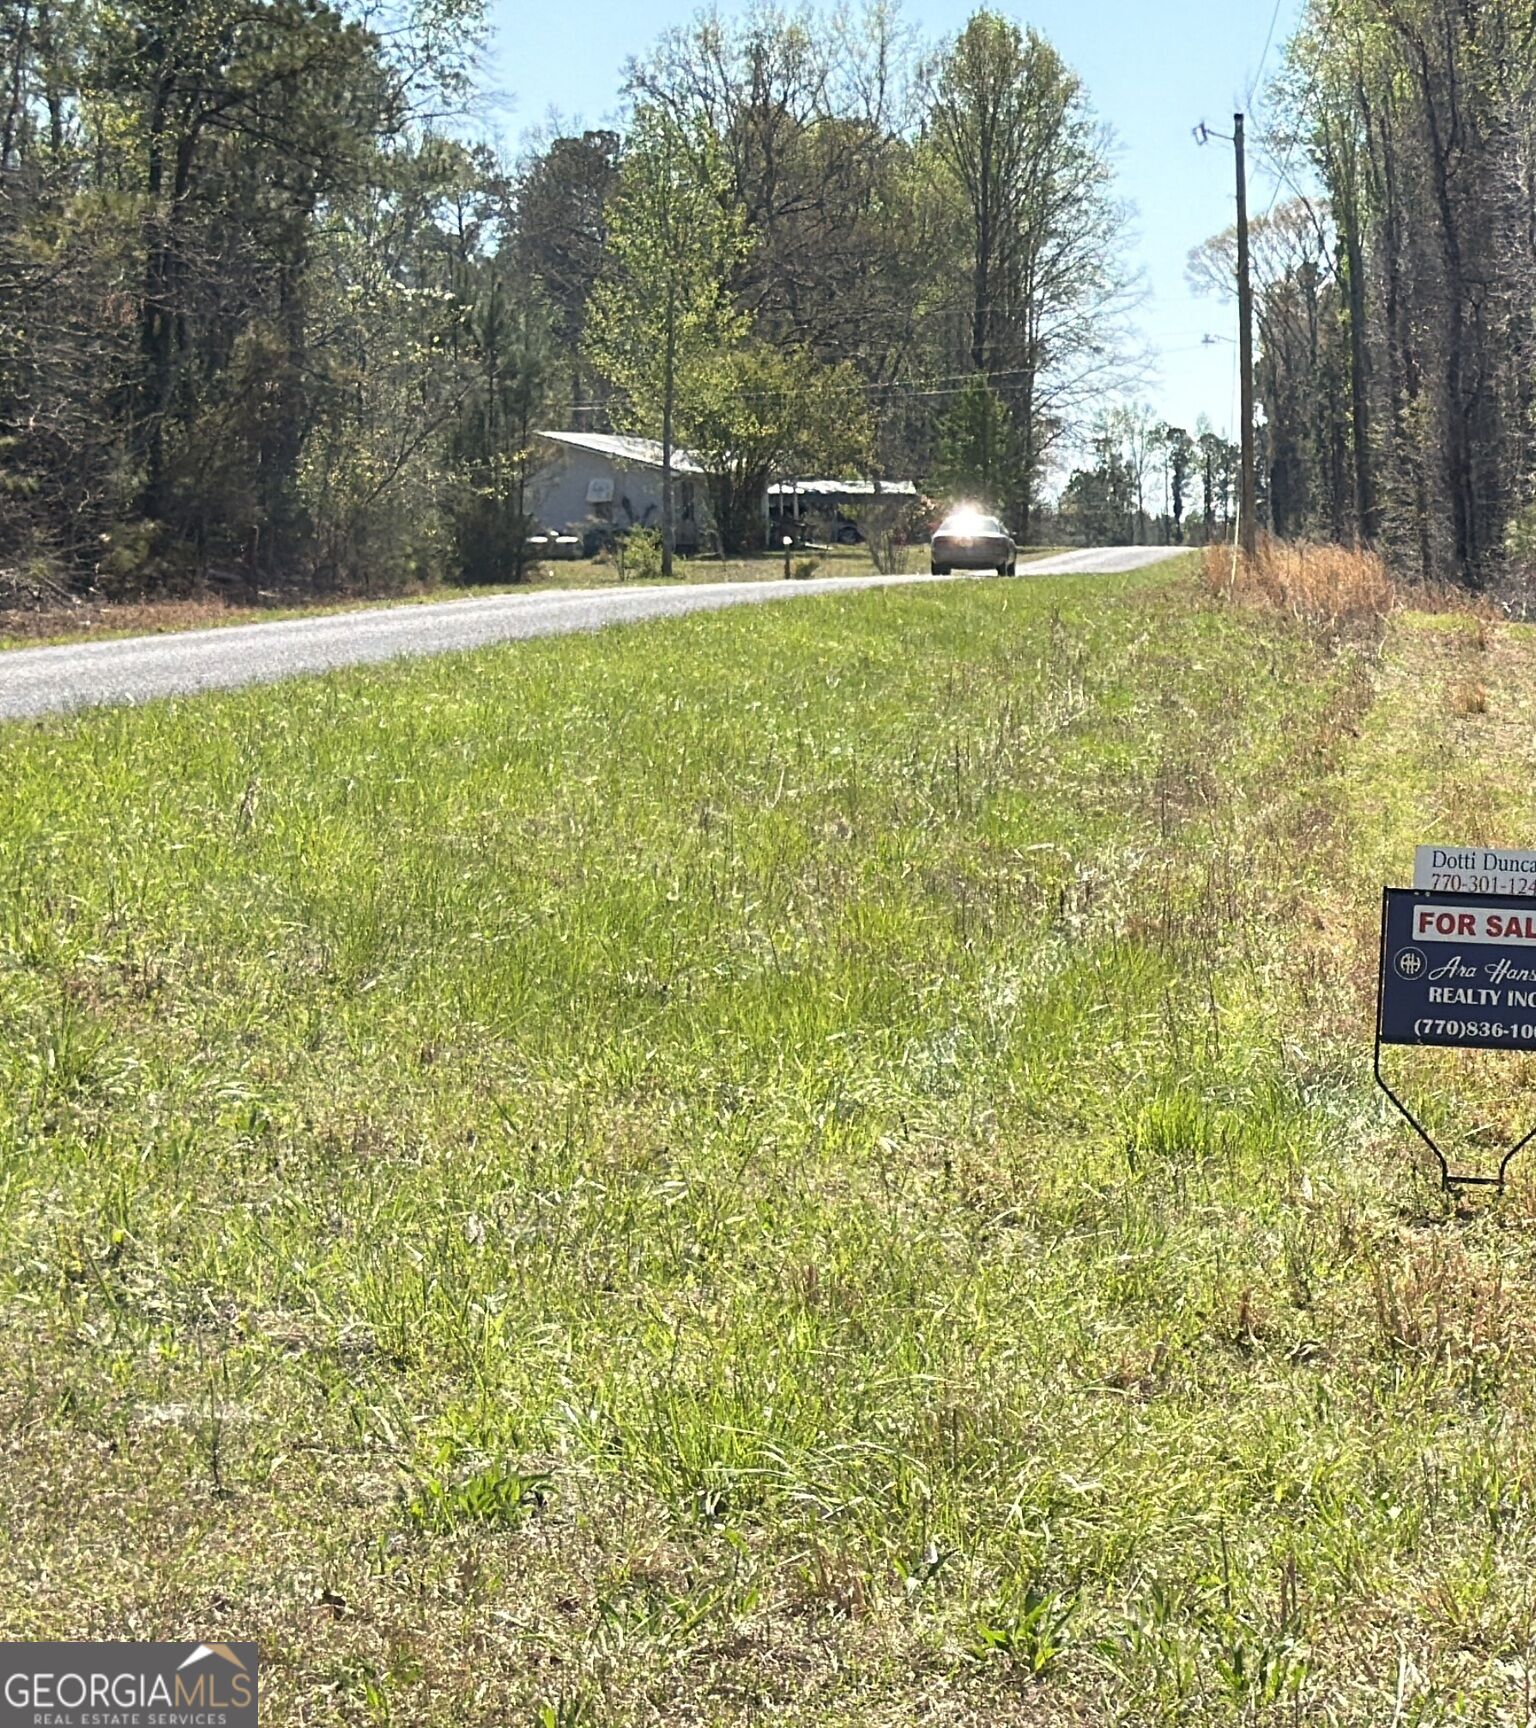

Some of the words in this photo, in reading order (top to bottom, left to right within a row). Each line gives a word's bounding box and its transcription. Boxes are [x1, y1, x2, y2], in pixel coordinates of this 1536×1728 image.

[1432, 850, 1476, 871] Dotti
[1418, 912, 1476, 937] FOR
[1428, 956, 1477, 981] Ara
[1429, 986, 1501, 1007] REALTY
